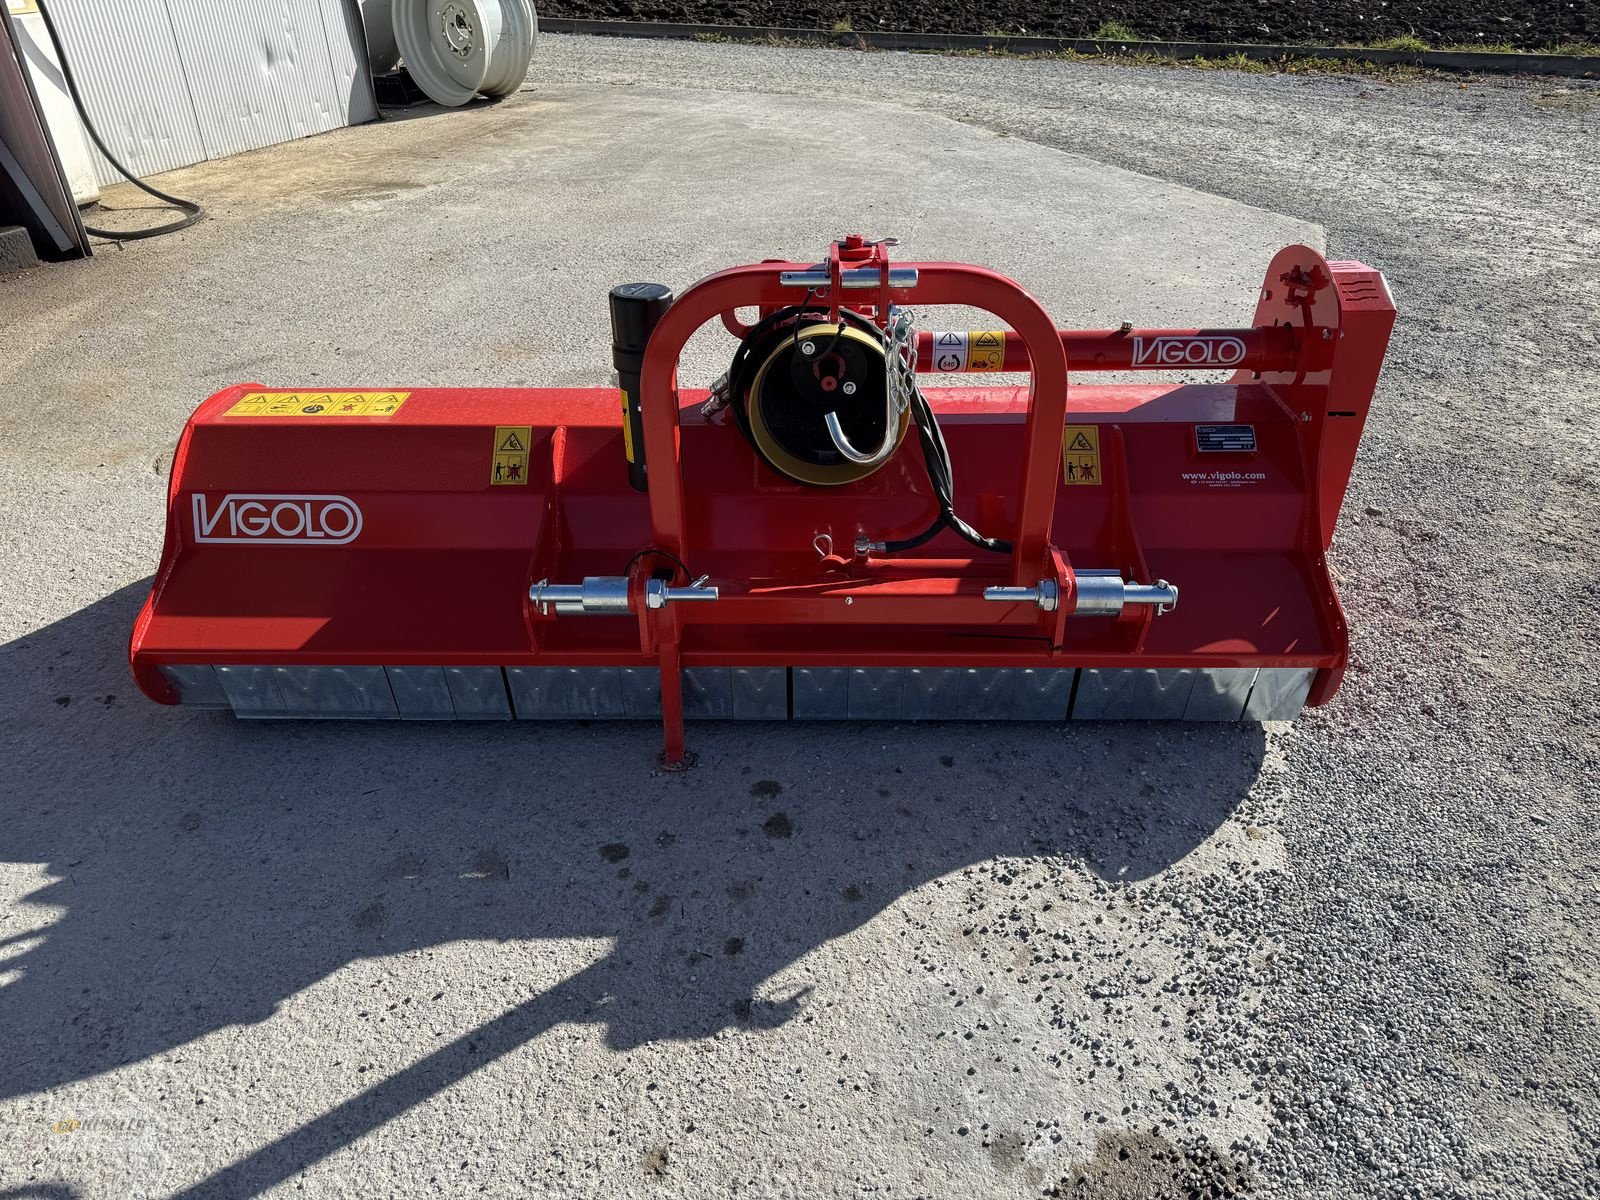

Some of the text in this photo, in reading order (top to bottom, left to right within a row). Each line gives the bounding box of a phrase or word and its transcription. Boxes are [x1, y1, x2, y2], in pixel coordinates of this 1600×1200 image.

[1131, 336, 1247, 367] VIGOLO
[1181, 471, 1266, 481] www.vigolo.com
[192, 493, 363, 544] VIGOLO
